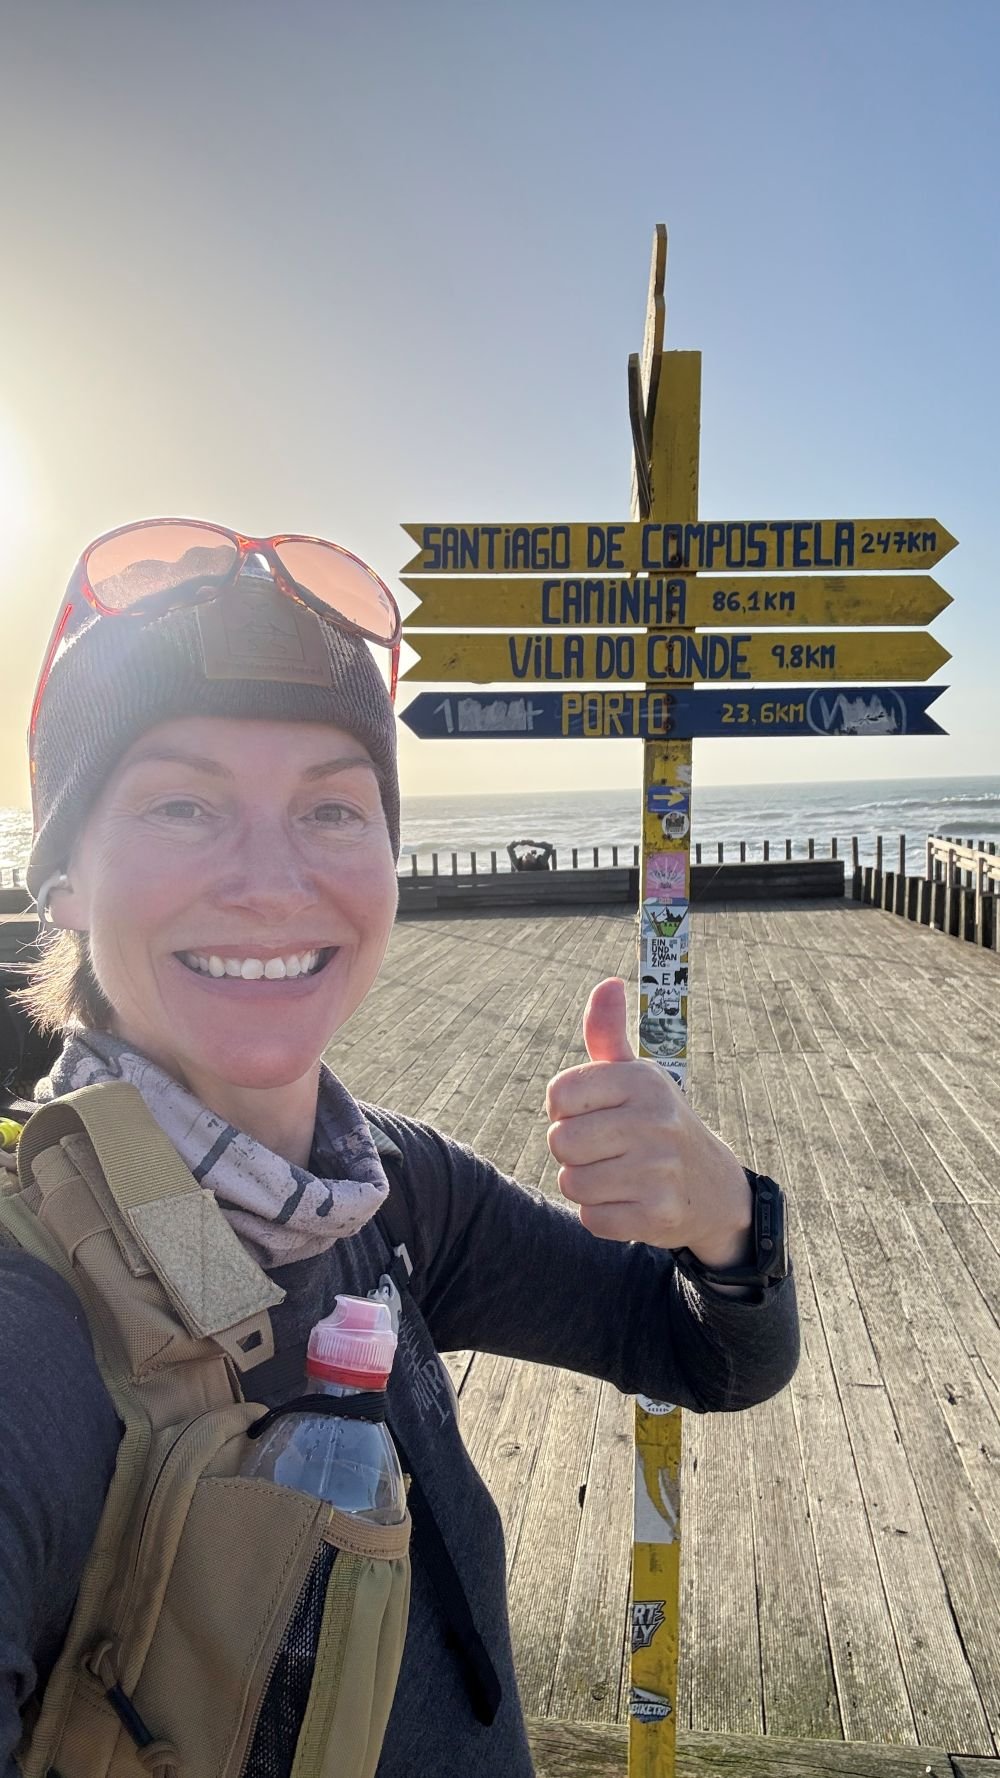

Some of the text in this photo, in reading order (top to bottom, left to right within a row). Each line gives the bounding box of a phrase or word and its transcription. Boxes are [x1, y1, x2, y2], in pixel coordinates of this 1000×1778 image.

[587, 526, 626, 569] DE
[641, 522, 855, 570] COMPOSTELA
[861, 531, 937, 554] 247KM
[596, 635, 635, 679] DO
[647, 634, 752, 680] CONDE
[562, 692, 669, 736] PORTO
[652, 953, 677, 961] ZWAN
[662, 972, 671, 986] E
